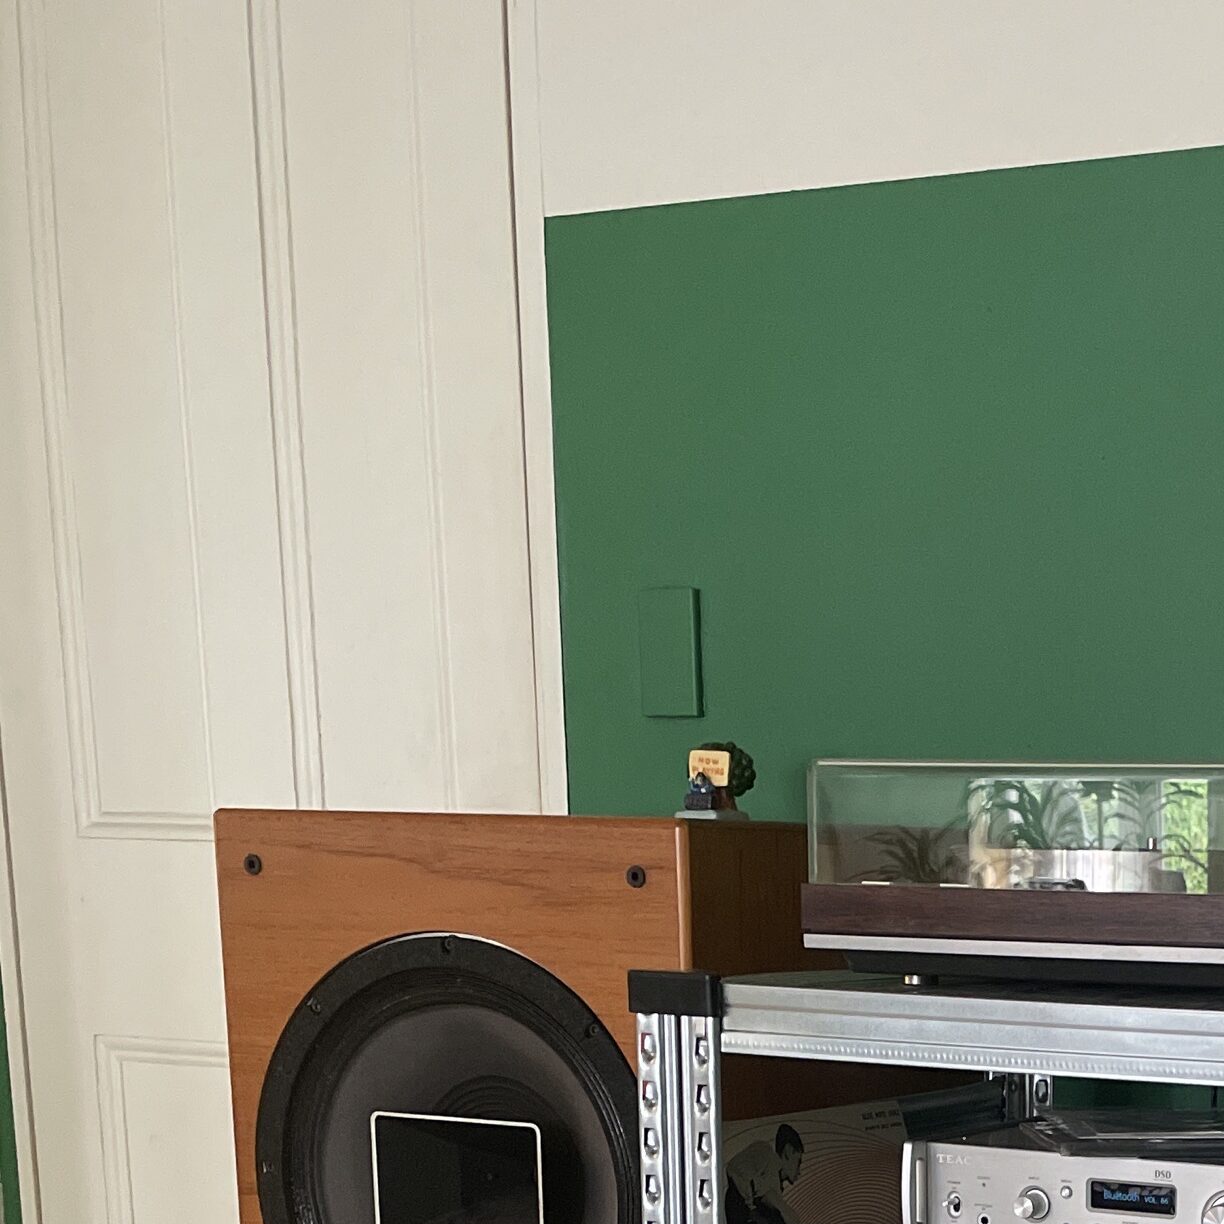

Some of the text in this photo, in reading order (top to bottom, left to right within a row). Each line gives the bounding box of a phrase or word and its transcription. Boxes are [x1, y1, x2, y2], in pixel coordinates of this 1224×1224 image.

[936, 1153, 973, 1165] TEAC
[1154, 1169, 1172, 1179] DSD
[1103, 1189, 1139, 1202] Bluetooth
